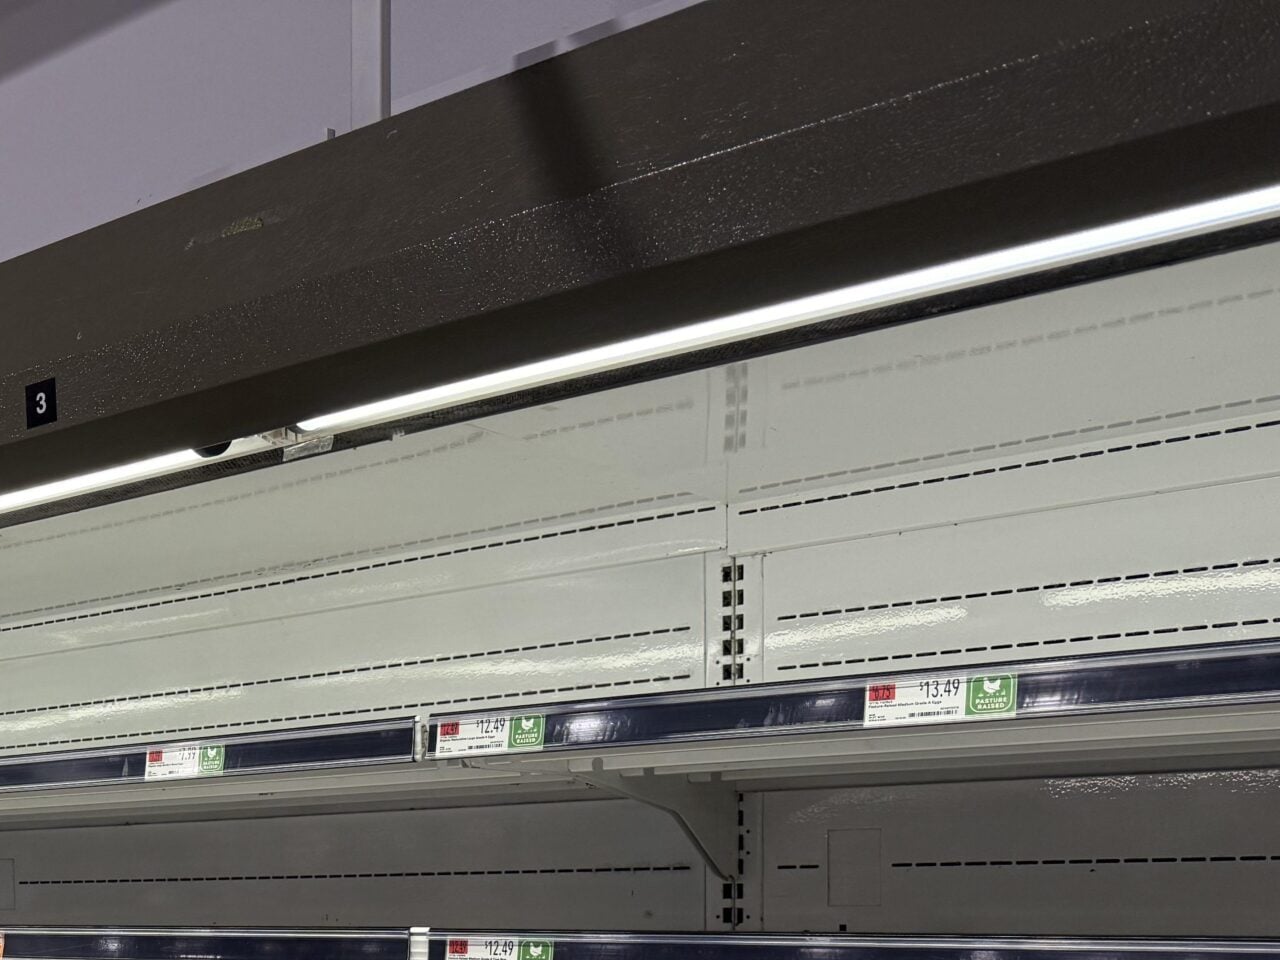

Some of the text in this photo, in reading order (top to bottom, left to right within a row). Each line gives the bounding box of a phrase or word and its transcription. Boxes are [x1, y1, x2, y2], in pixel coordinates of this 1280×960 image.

[35, 392, 47, 414] 3
[920, 679, 960, 698] $13.49
[477, 718, 505, 734] $12.49
[485, 941, 513, 956] $12.49
